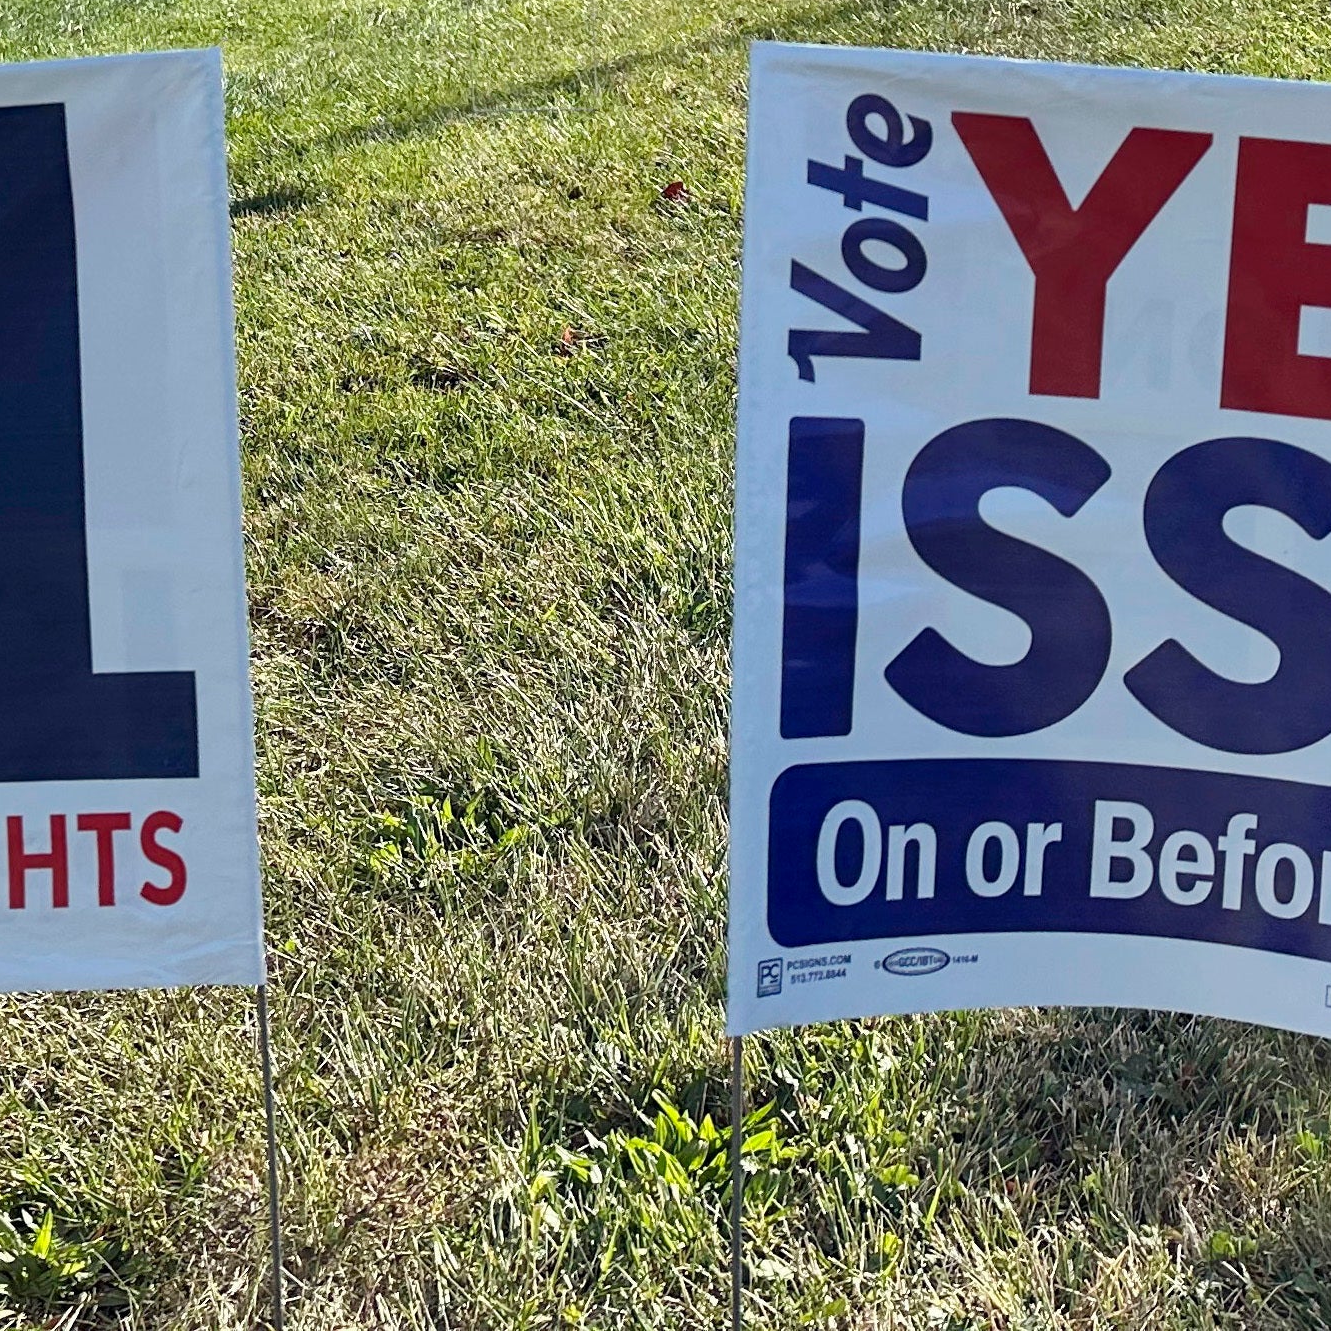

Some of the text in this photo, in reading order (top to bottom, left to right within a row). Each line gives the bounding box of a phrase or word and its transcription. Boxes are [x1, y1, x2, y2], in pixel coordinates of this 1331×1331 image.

[789, 93, 933, 383] Vote
[816, 798, 936, 907] On
[965, 819, 1064, 899] or
